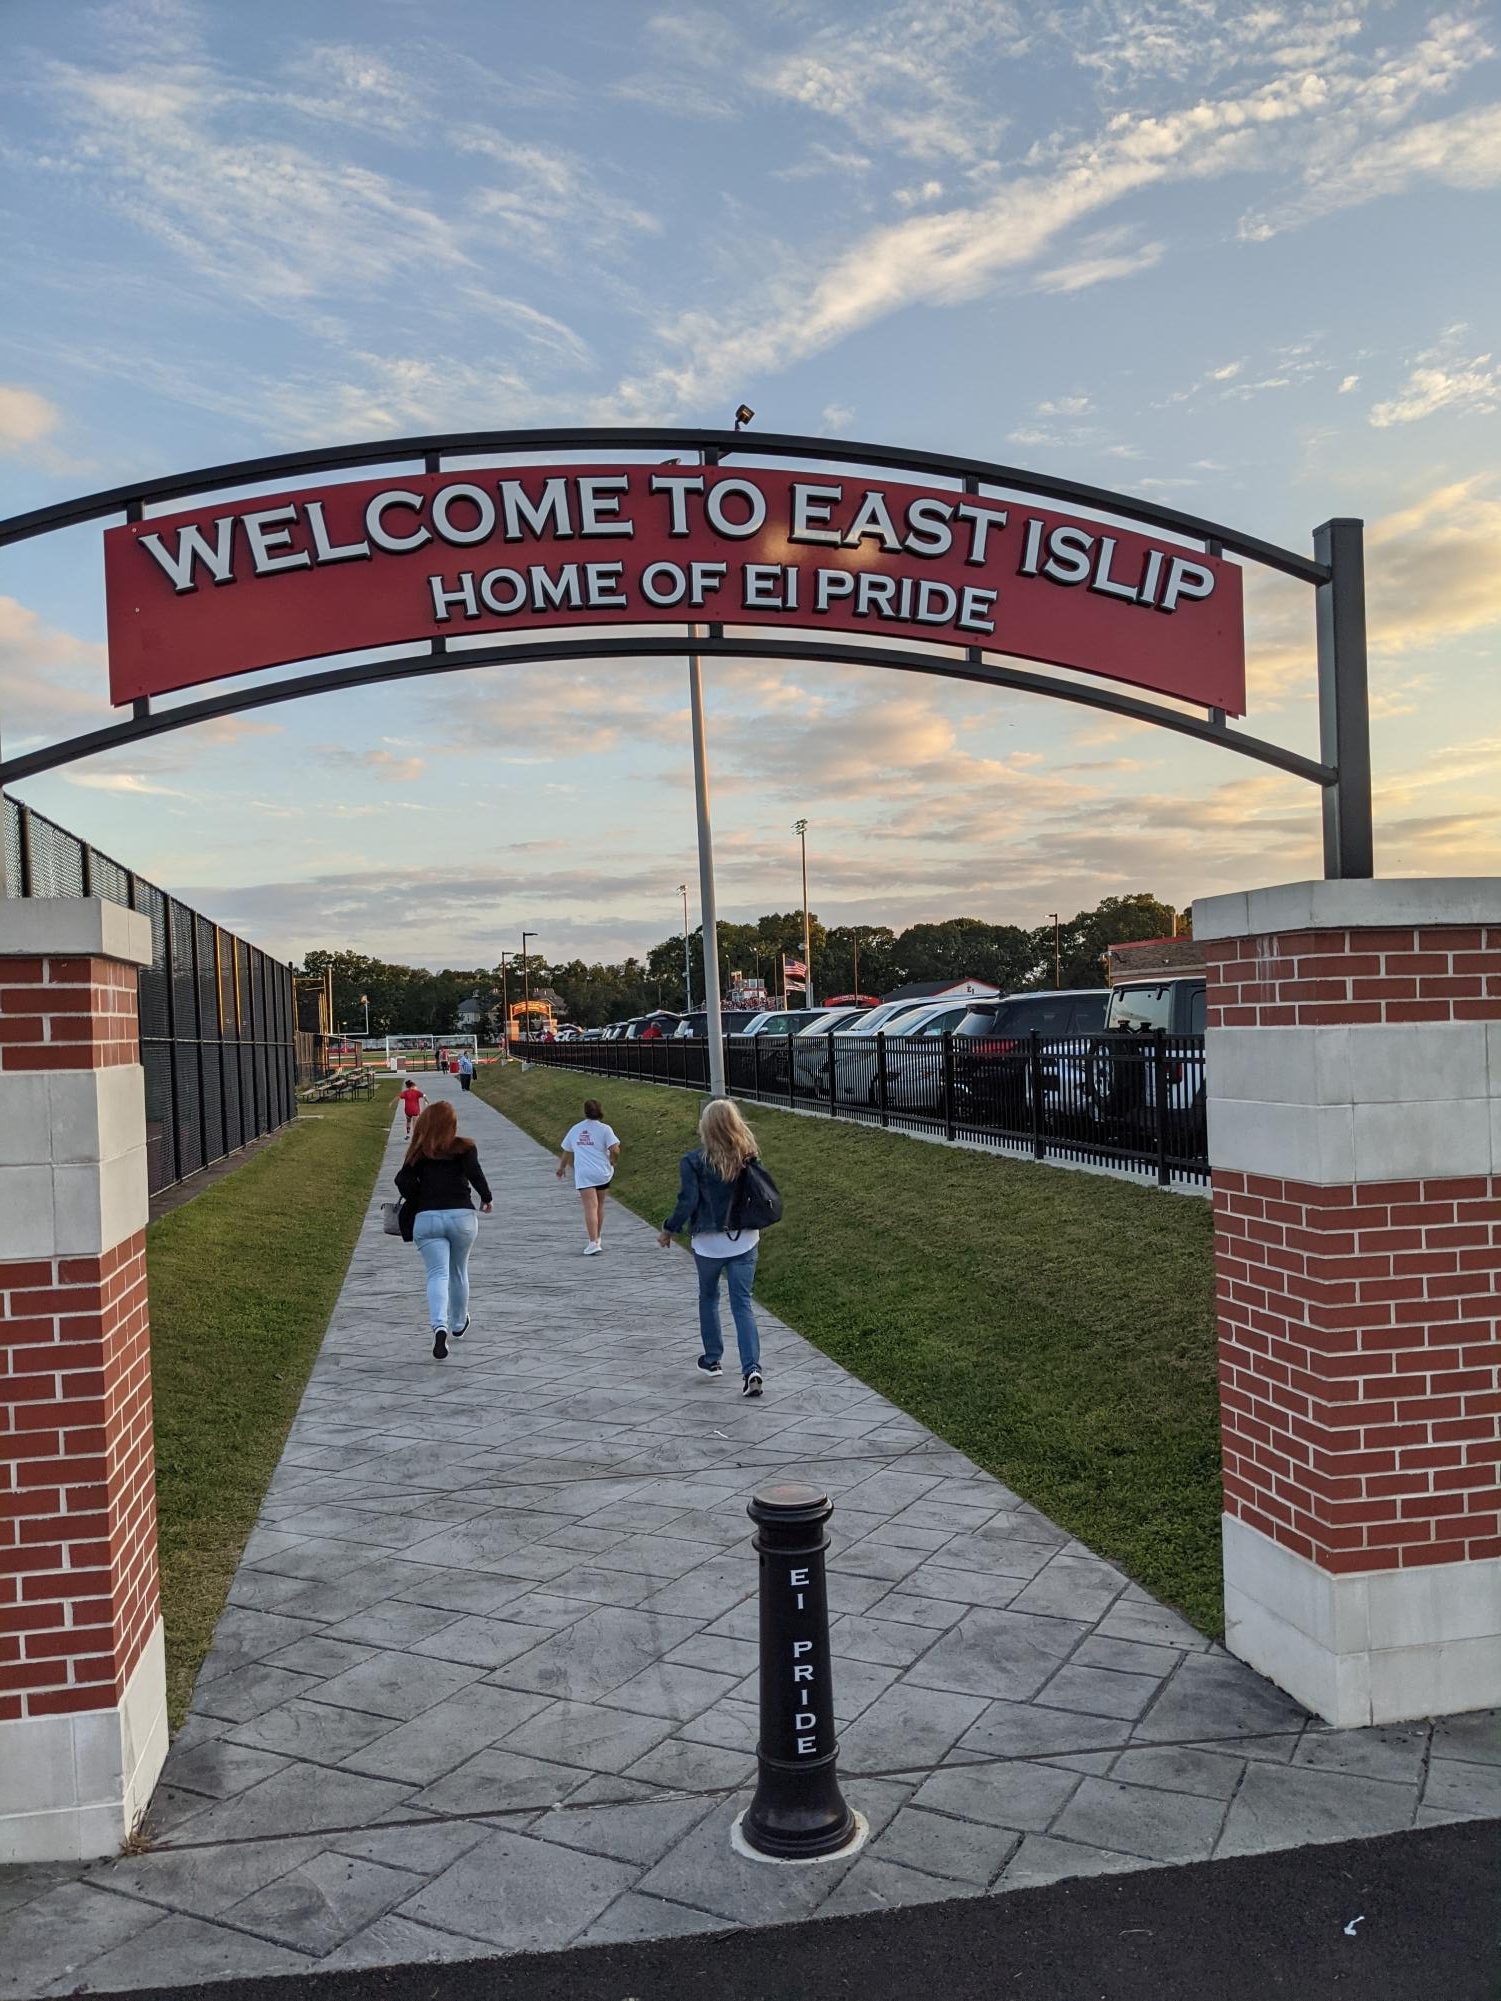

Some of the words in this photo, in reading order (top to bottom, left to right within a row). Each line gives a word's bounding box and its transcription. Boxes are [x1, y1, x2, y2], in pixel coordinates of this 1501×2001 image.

[137, 474, 635, 593] WELCOME
[650, 474, 767, 538] TO
[788, 482, 1008, 566] EAST
[1019, 518, 1216, 612] ISLIP
[428, 560, 628, 622] HOME
[641, 560, 728, 606] OF
[742, 563, 799, 610] EI
[814, 567, 998, 633] PRIDE
[790, 1568, 810, 1610] EI
[793, 1640, 817, 1754] PRIDE
